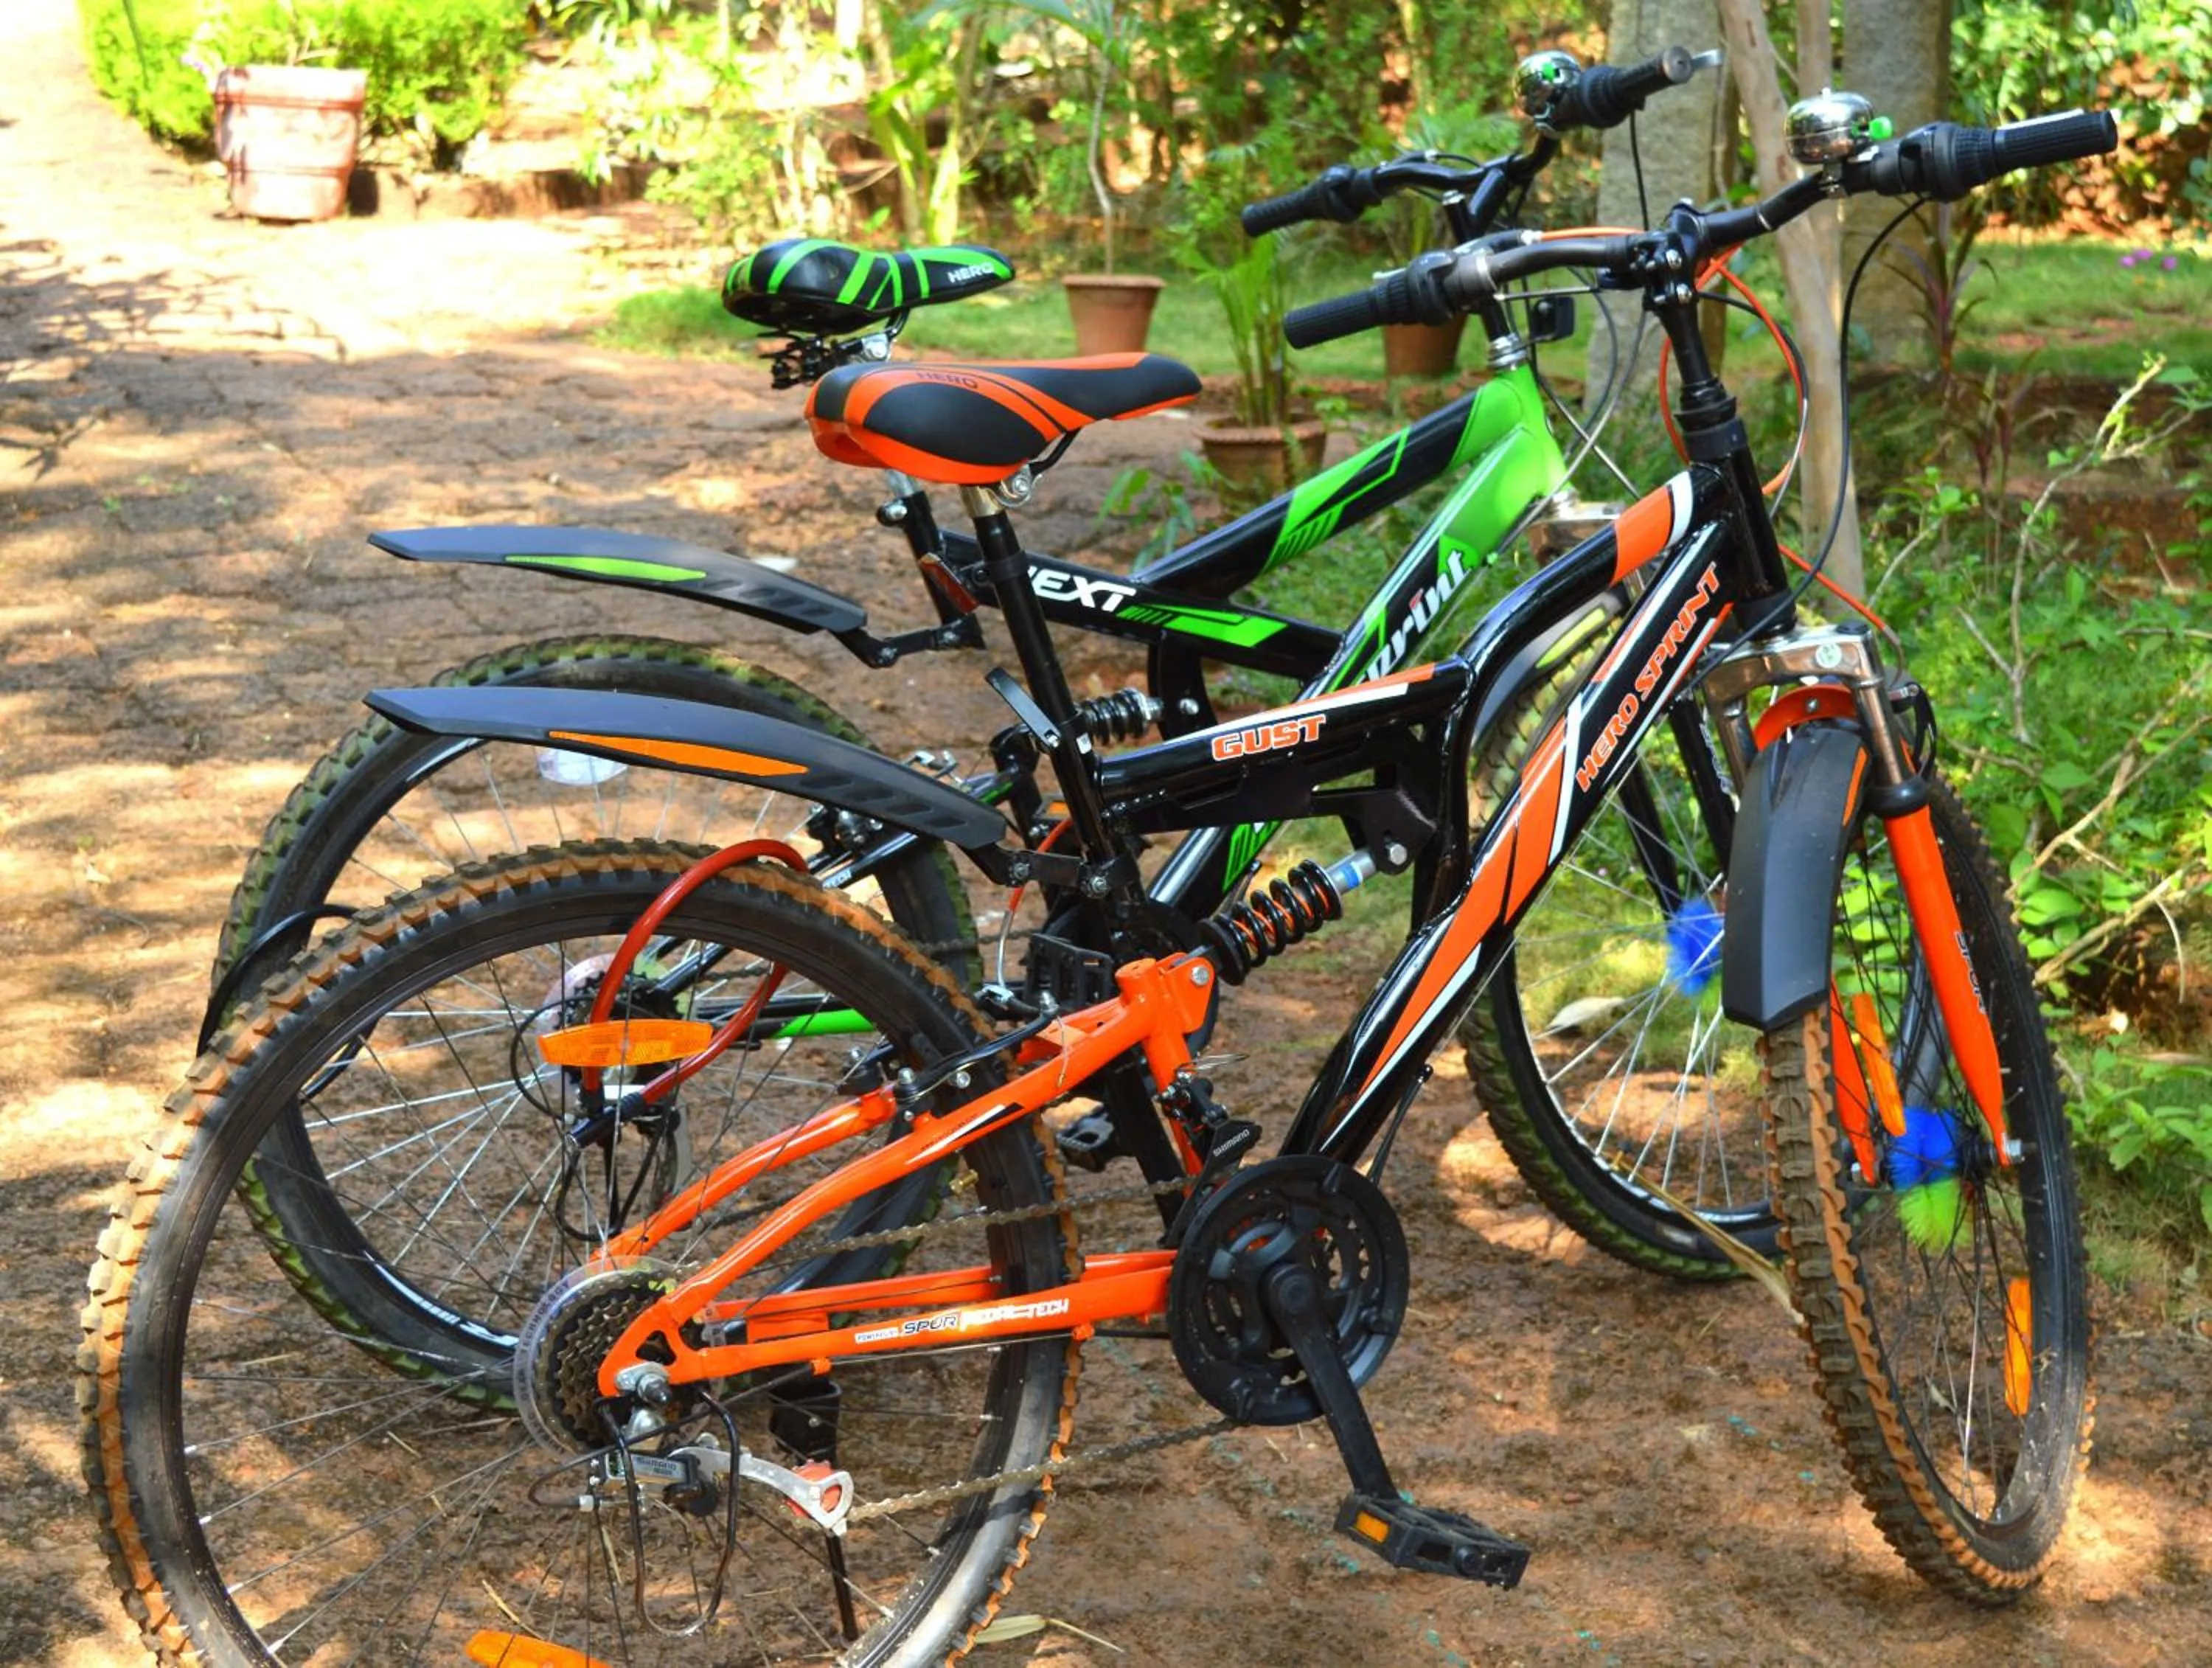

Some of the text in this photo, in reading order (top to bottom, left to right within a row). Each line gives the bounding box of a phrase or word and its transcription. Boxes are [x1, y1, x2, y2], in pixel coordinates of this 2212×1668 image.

[947, 263, 995, 283] HERO
[1576, 693, 1639, 793] HERO
[1635, 561, 1720, 701] SPRINT
[1211, 714, 1326, 762] GUST
